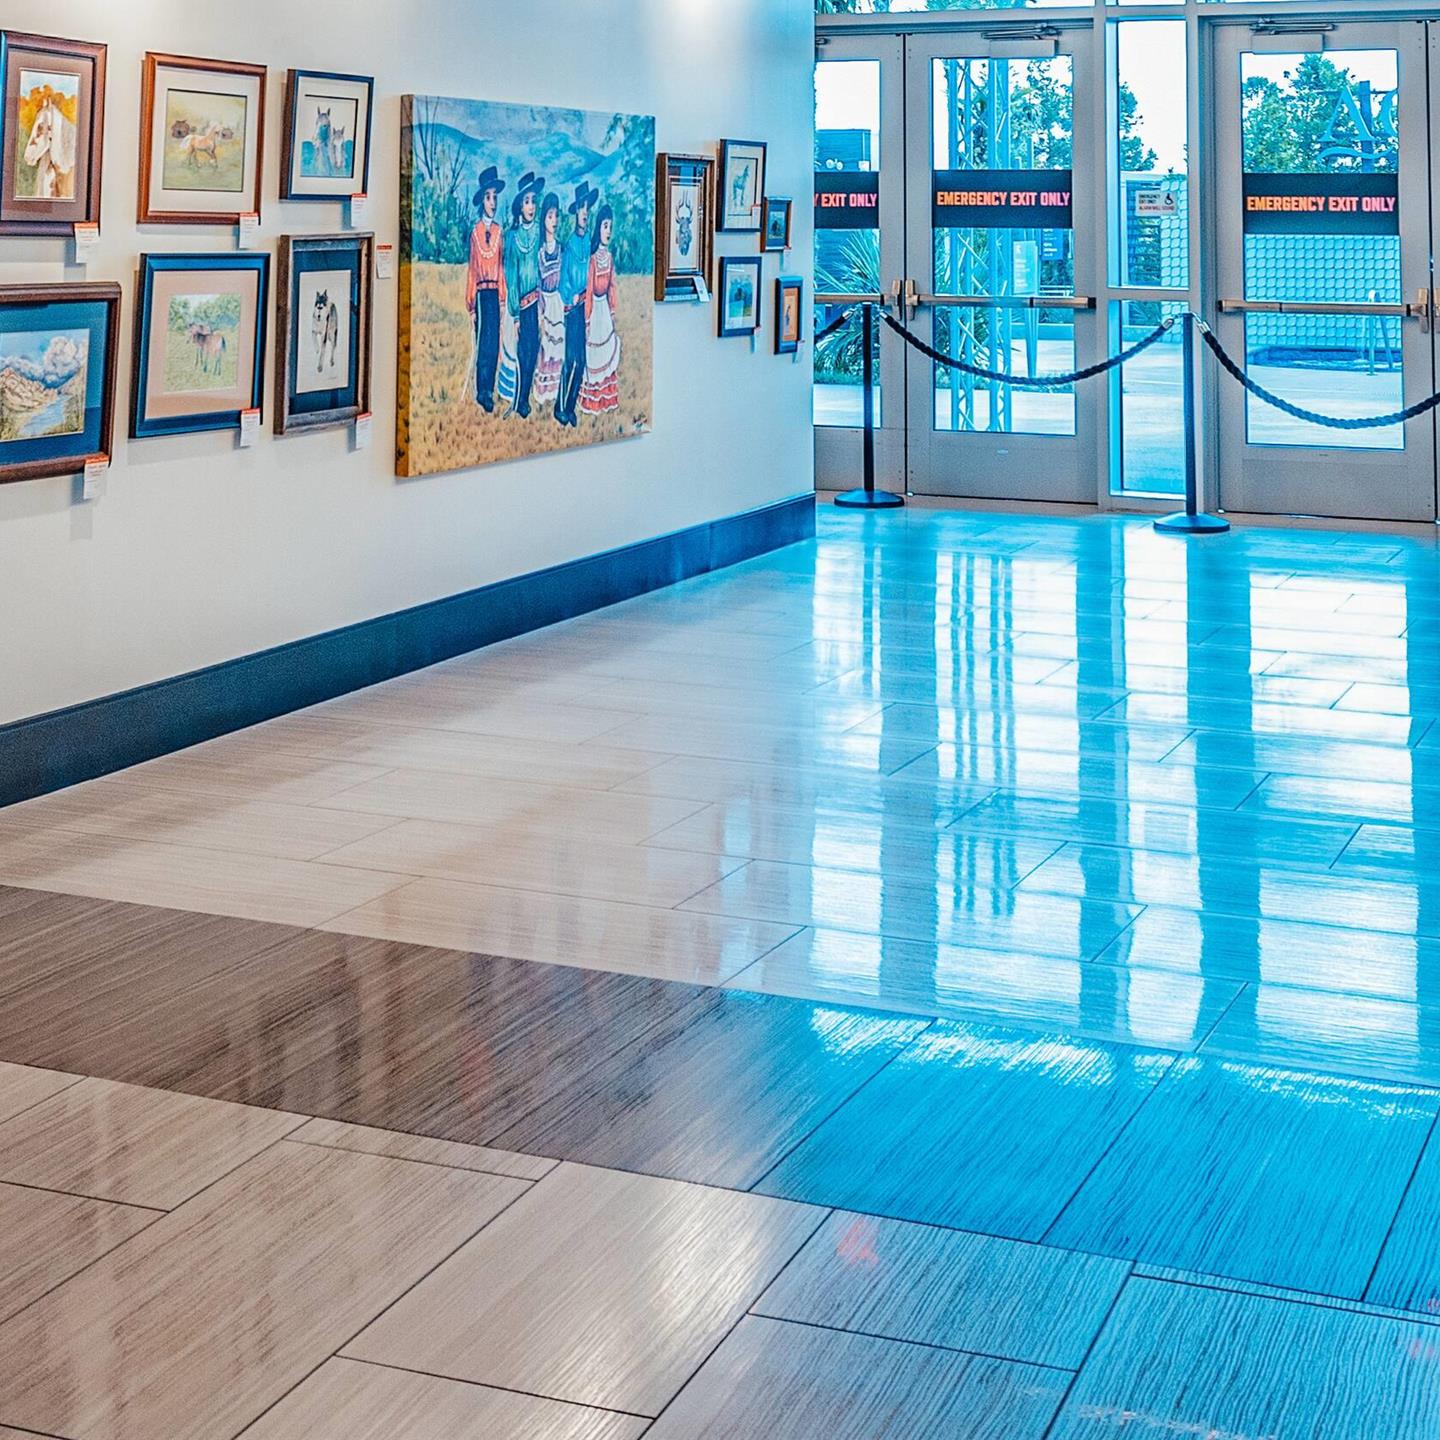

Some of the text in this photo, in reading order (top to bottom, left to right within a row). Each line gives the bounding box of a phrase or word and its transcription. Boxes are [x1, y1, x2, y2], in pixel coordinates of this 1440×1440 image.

[821, 193, 847, 208] EXIT
[849, 193, 878, 208] ONLY
[936, 191, 1071, 207] EMERGENCY EXIT ONLY
[1247, 196, 1396, 212] EMERGENCY EXIT ONLY
